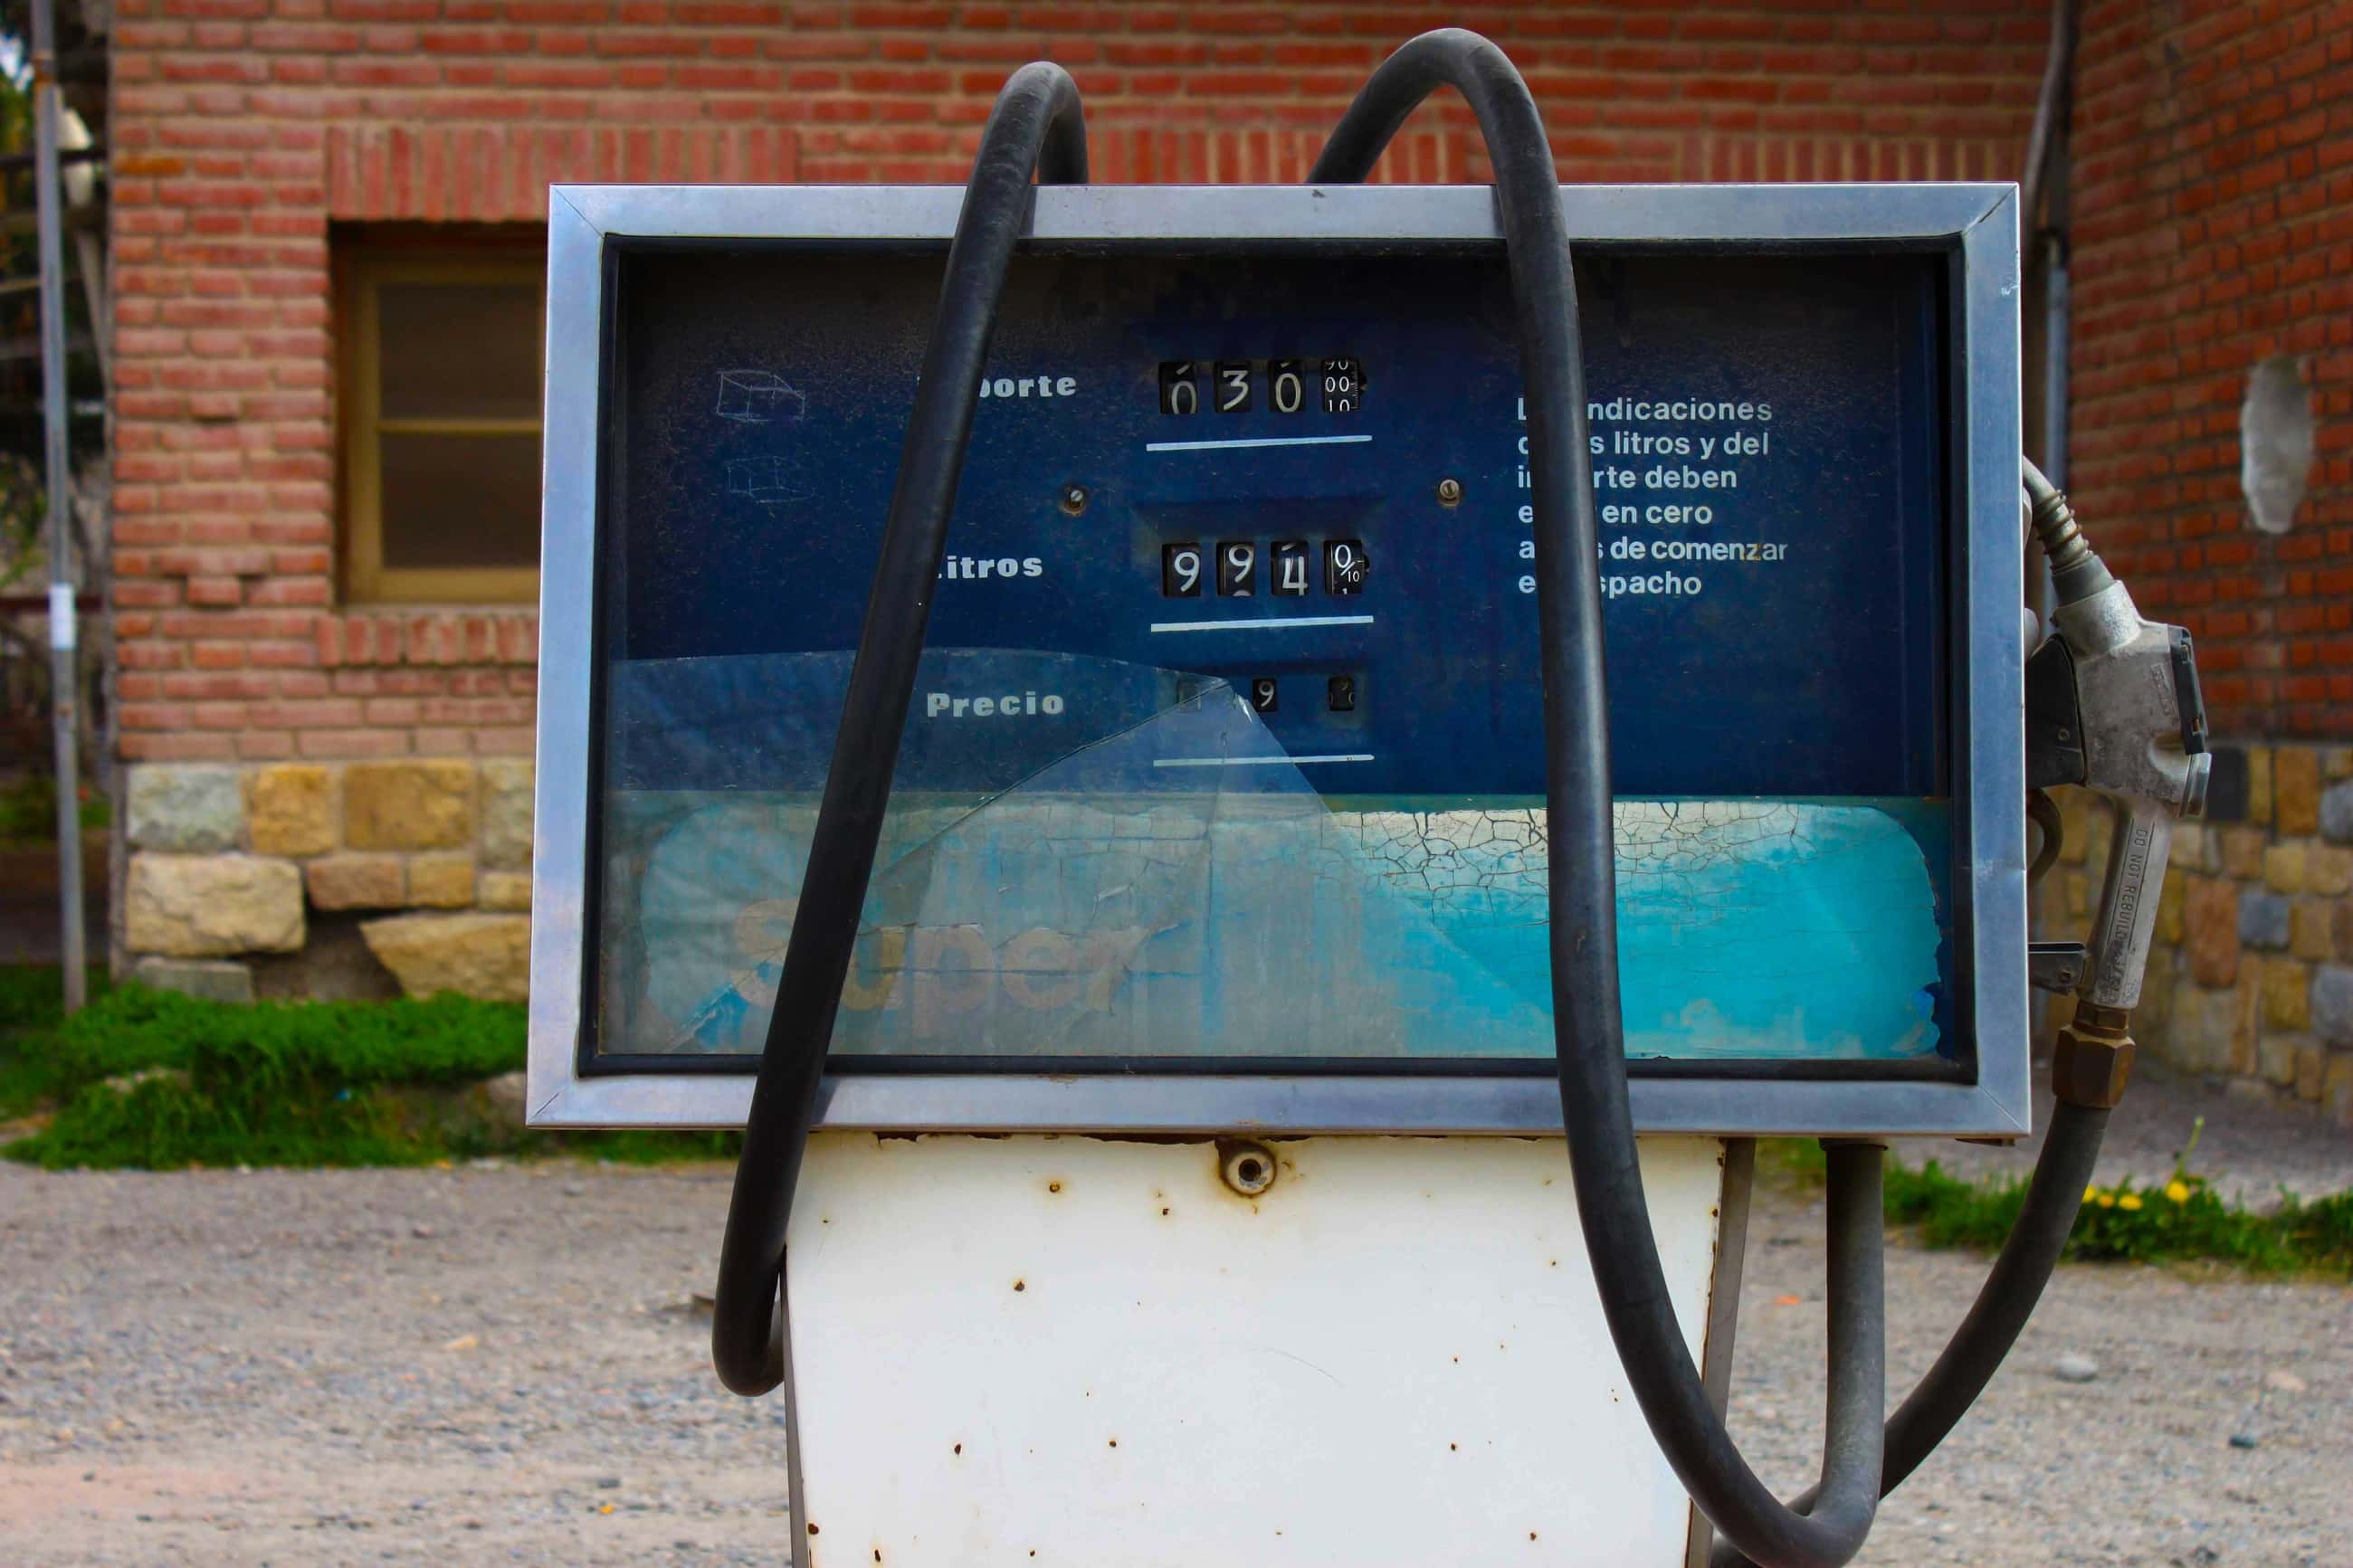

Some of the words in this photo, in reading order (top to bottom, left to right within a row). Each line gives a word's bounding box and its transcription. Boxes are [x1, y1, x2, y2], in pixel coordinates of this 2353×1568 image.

[917, 375, 1077, 398] orte
[1586, 397, 1773, 421] ndicaciones
[1615, 431, 1691, 455] litros
[1700, 436, 1716, 460] y
[1723, 432, 1769, 455] del
[1643, 465, 1738, 489] deben
[1601, 505, 1638, 524] en
[1644, 505, 1713, 525] cero
[1609, 537, 1646, 560] de
[1651, 540, 1789, 561] comenzar
[938, 556, 1043, 579] itros
[926, 690, 1064, 717] Precio
[1258, 680, 1275, 708] 9
[2127, 854, 2143, 879] NOT
